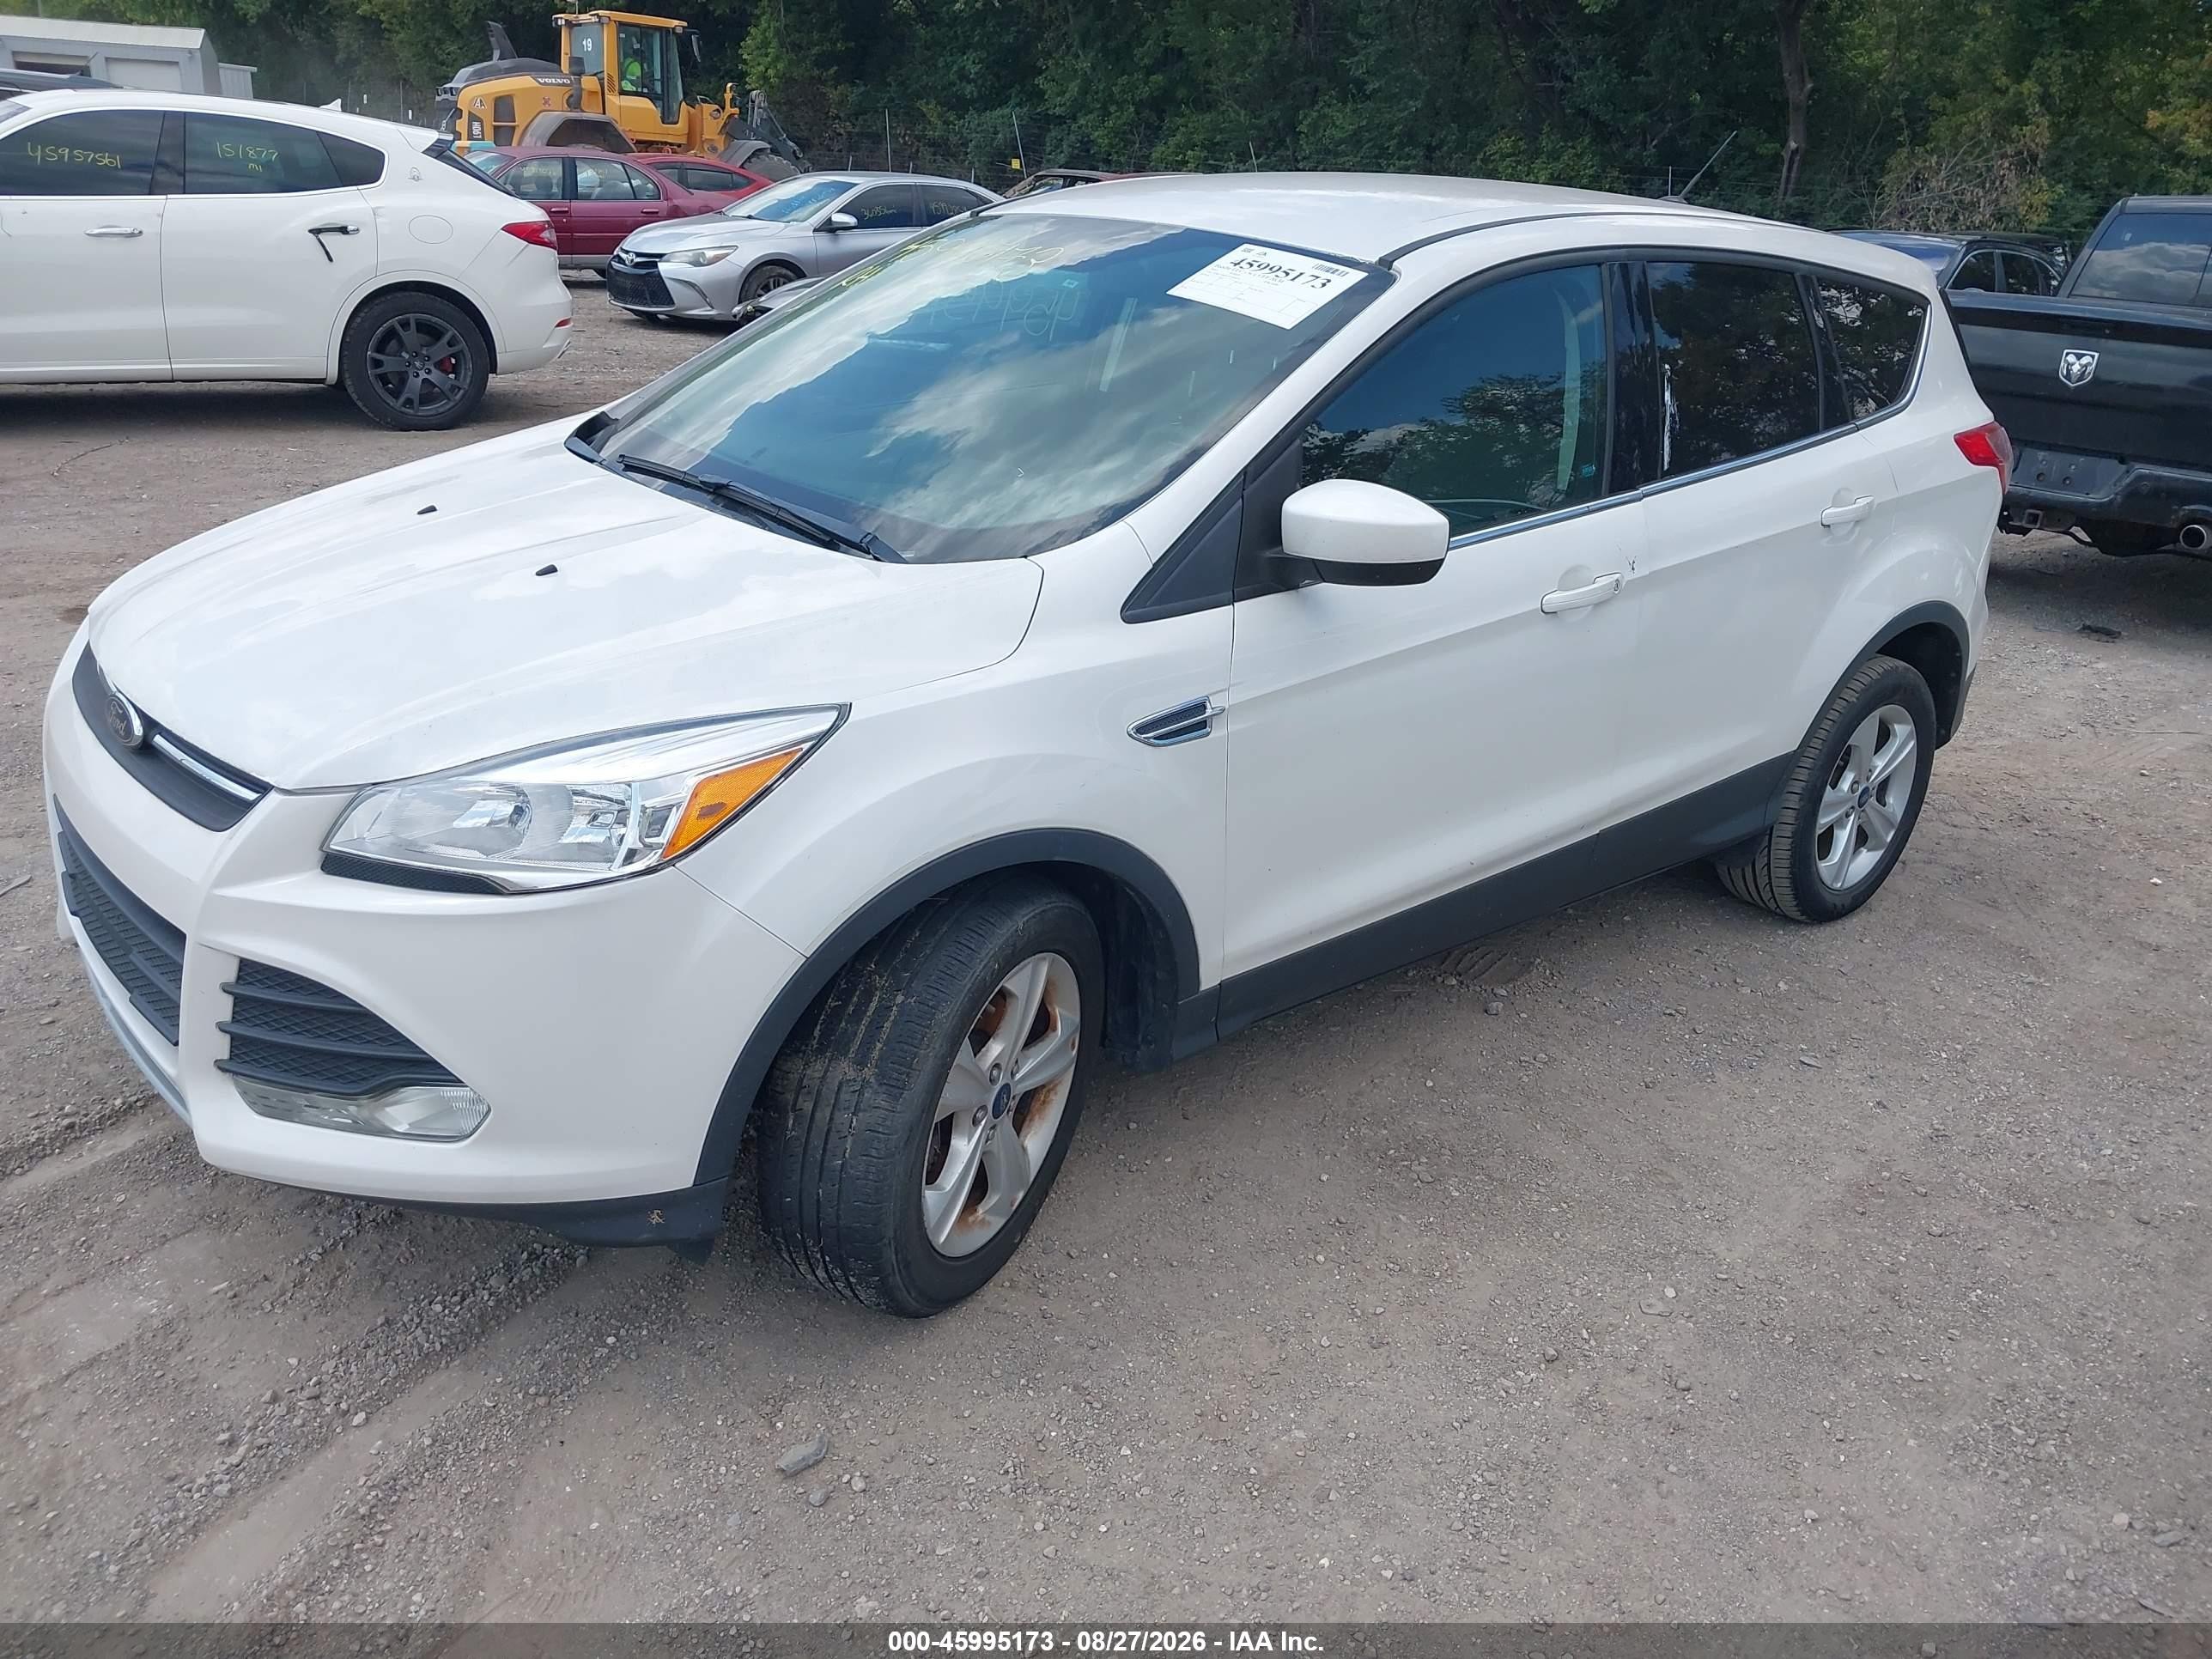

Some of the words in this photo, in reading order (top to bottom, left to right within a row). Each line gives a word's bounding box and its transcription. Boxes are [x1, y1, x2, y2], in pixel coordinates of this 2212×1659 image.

[582, 38, 592, 52] 19
[27, 142, 121, 168] 45957561
[216, 142, 278, 161] 151877
[1230, 257, 1332, 289] 45995173
